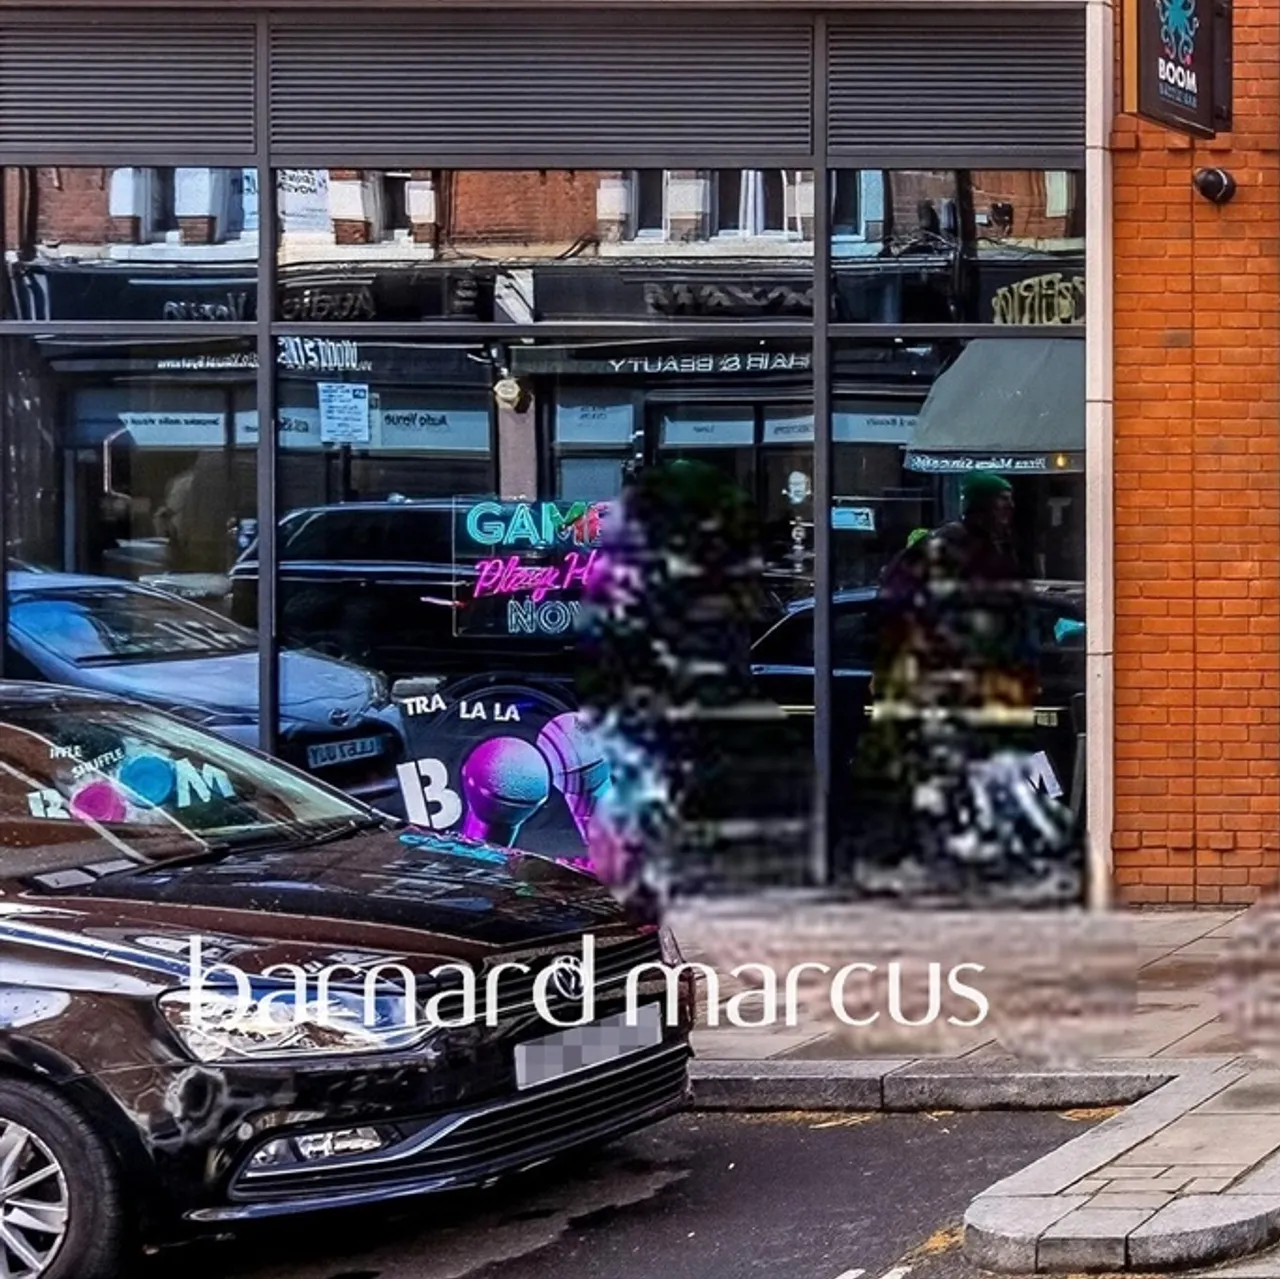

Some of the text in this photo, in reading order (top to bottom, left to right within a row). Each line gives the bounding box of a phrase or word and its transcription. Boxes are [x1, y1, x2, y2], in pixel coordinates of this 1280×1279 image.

[1158, 57, 1198, 94] BOOM
[508, 599, 582, 634] NO
[402, 693, 521, 722] TRA LA LA
